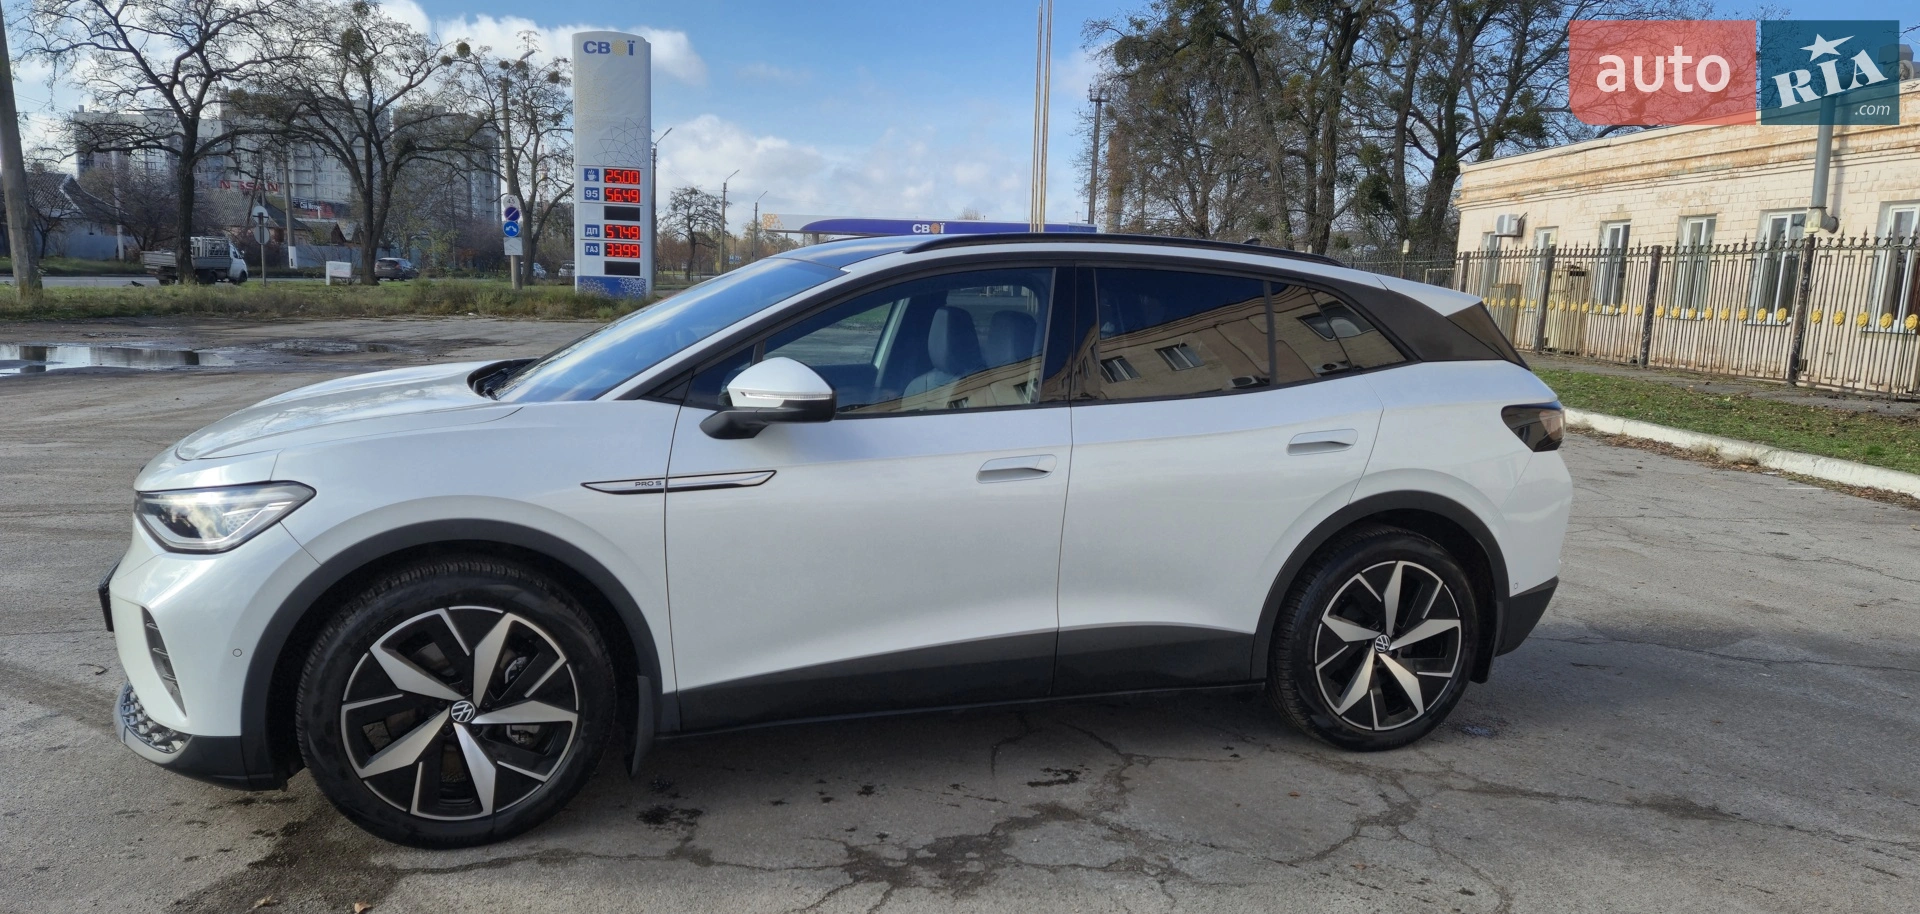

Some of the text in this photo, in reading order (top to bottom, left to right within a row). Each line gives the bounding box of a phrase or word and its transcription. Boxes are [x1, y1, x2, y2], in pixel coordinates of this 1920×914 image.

[606, 169, 639, 184] 25.00
[219, 180, 279, 192] NSSAN
[585, 189, 598, 198] 95
[606, 188, 639, 203] 56.49
[586, 227, 598, 236] ДП
[606, 225, 639, 240] 57.49
[585, 245, 599, 253] ГАЗ
[606, 243, 639, 258] 33.99
